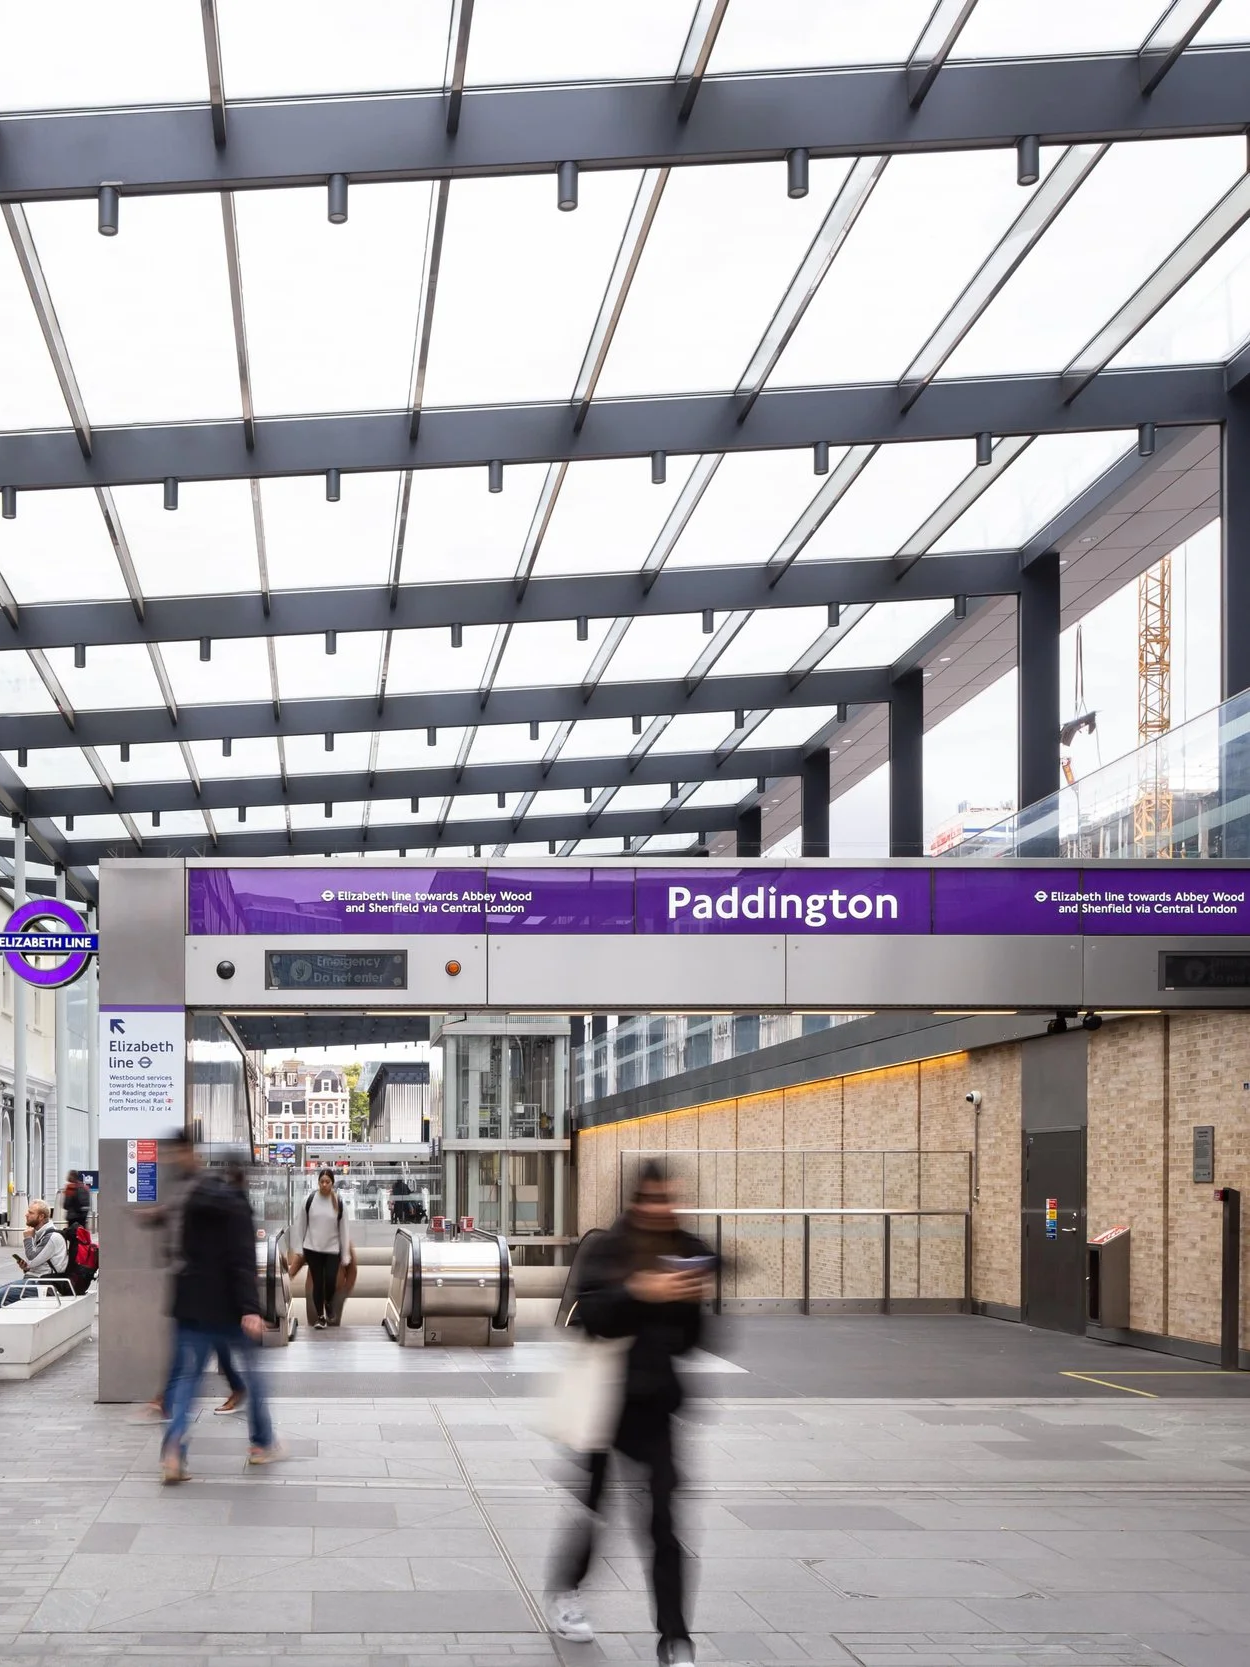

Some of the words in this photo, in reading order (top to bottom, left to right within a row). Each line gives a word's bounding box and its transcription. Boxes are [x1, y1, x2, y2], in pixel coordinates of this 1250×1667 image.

[338, 891, 388, 901] Elizabeth
[392, 891, 412, 901] line
[415, 891, 458, 901] towards
[462, 891, 496, 903] Abbey
[500, 891, 532, 901] Wood
[1051, 892, 1101, 902] Elizabeth
[1105, 892, 1124, 902] line
[1128, 892, 1171, 902] towards
[1175, 892, 1209, 904] Abbey
[1212, 892, 1245, 902] Wood
[345, 903, 365, 913] and
[368, 903, 419, 913] Shenfield
[422, 903, 438, 913] via
[441, 903, 481, 913] Central
[484, 903, 524, 913] London
[668, 886, 898, 927] Paddington
[1058, 904, 1078, 913] and
[1081, 904, 1132, 913] Shenfield
[1135, 904, 1150, 913] via
[1154, 904, 1194, 913] Central
[1197, 904, 1237, 913] London
[65, 938, 92, 948] LINE
[317, 955, 380, 969] Emergency
[314, 972, 330, 982] Do
[332, 972, 351, 982] not
[354, 972, 384, 982] enter
[110, 1041, 174, 1052] Elizabeth
[110, 1057, 134, 1068] line
[431, 1332, 436, 1340] 2
